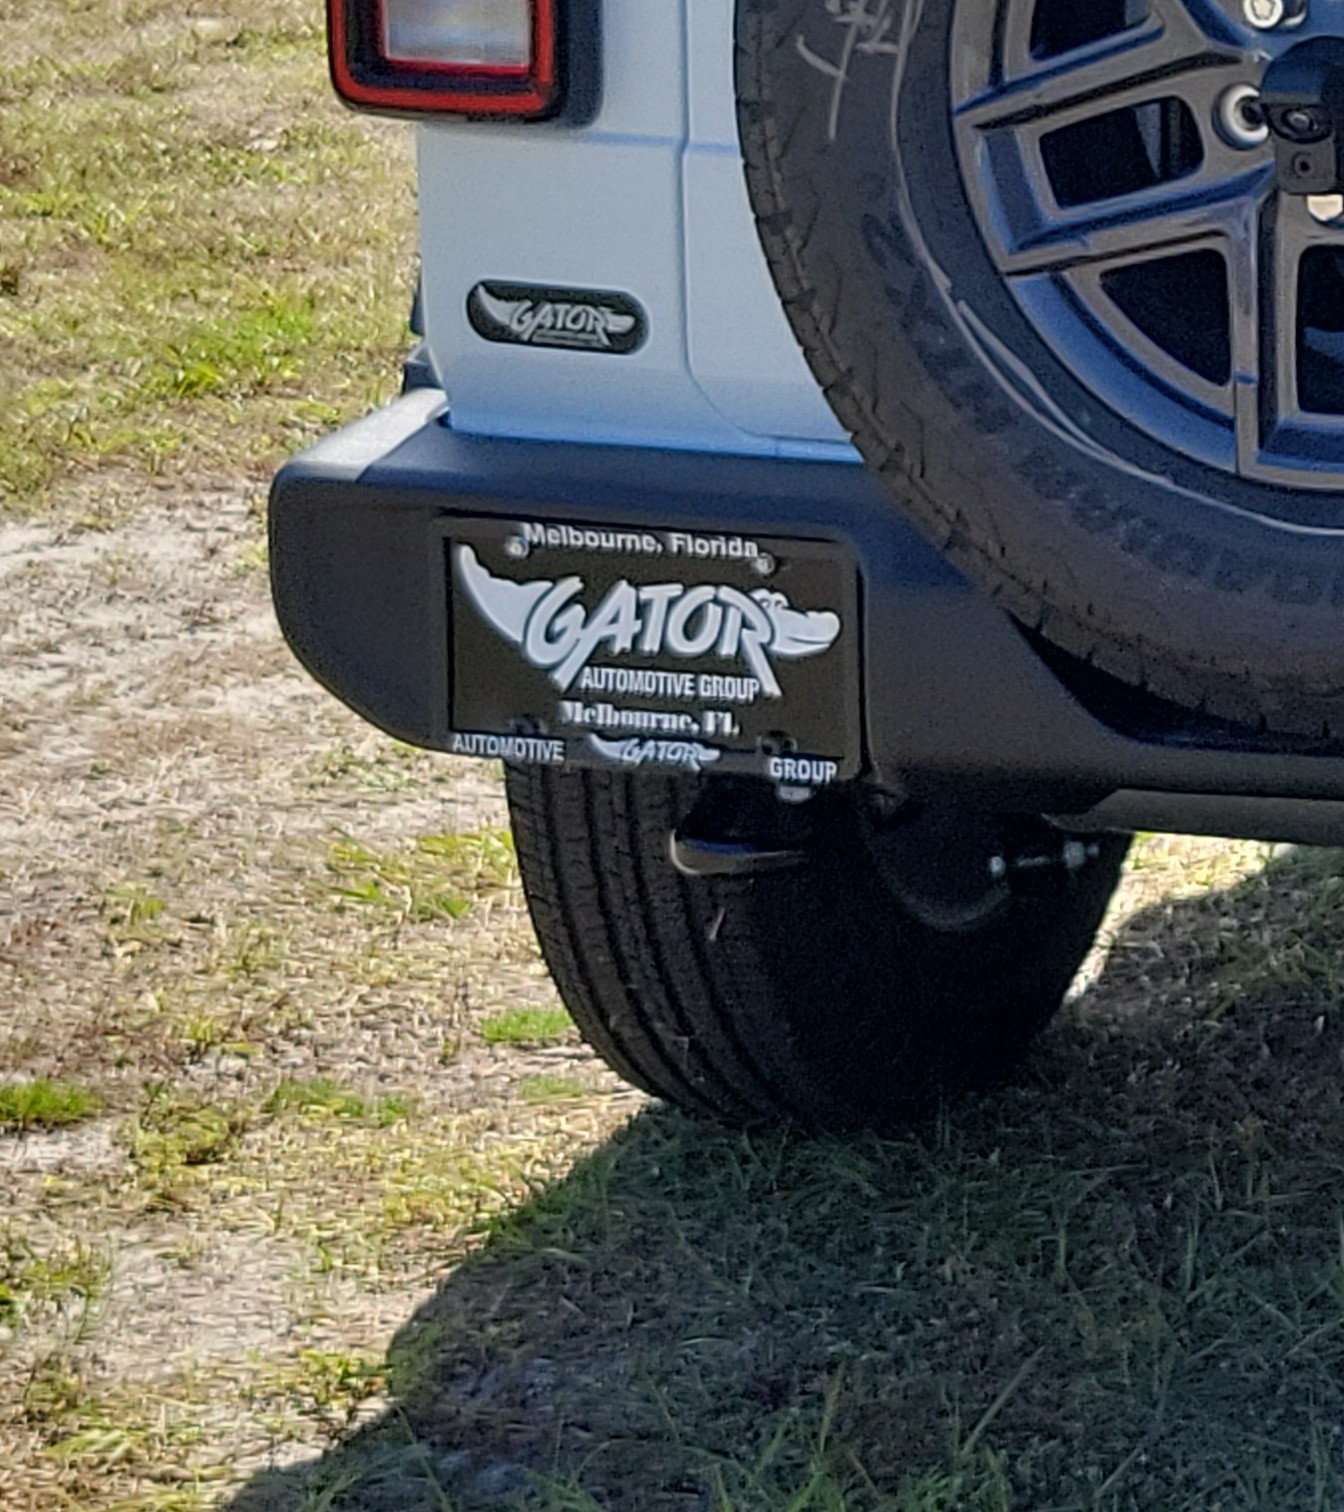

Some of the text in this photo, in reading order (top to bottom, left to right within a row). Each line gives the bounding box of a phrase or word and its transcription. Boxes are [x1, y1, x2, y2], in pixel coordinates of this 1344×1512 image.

[508, 299, 612, 347] GATOR
[522, 522, 760, 561] Melbourne, Florida
[521, 576, 782, 696] GATOR
[580, 665, 762, 703] AUTOMOTIVE GROUP
[560, 699, 700, 734] Melbourne,
[452, 732, 838, 783] AUTOMOTIVE GATOR GROUP
